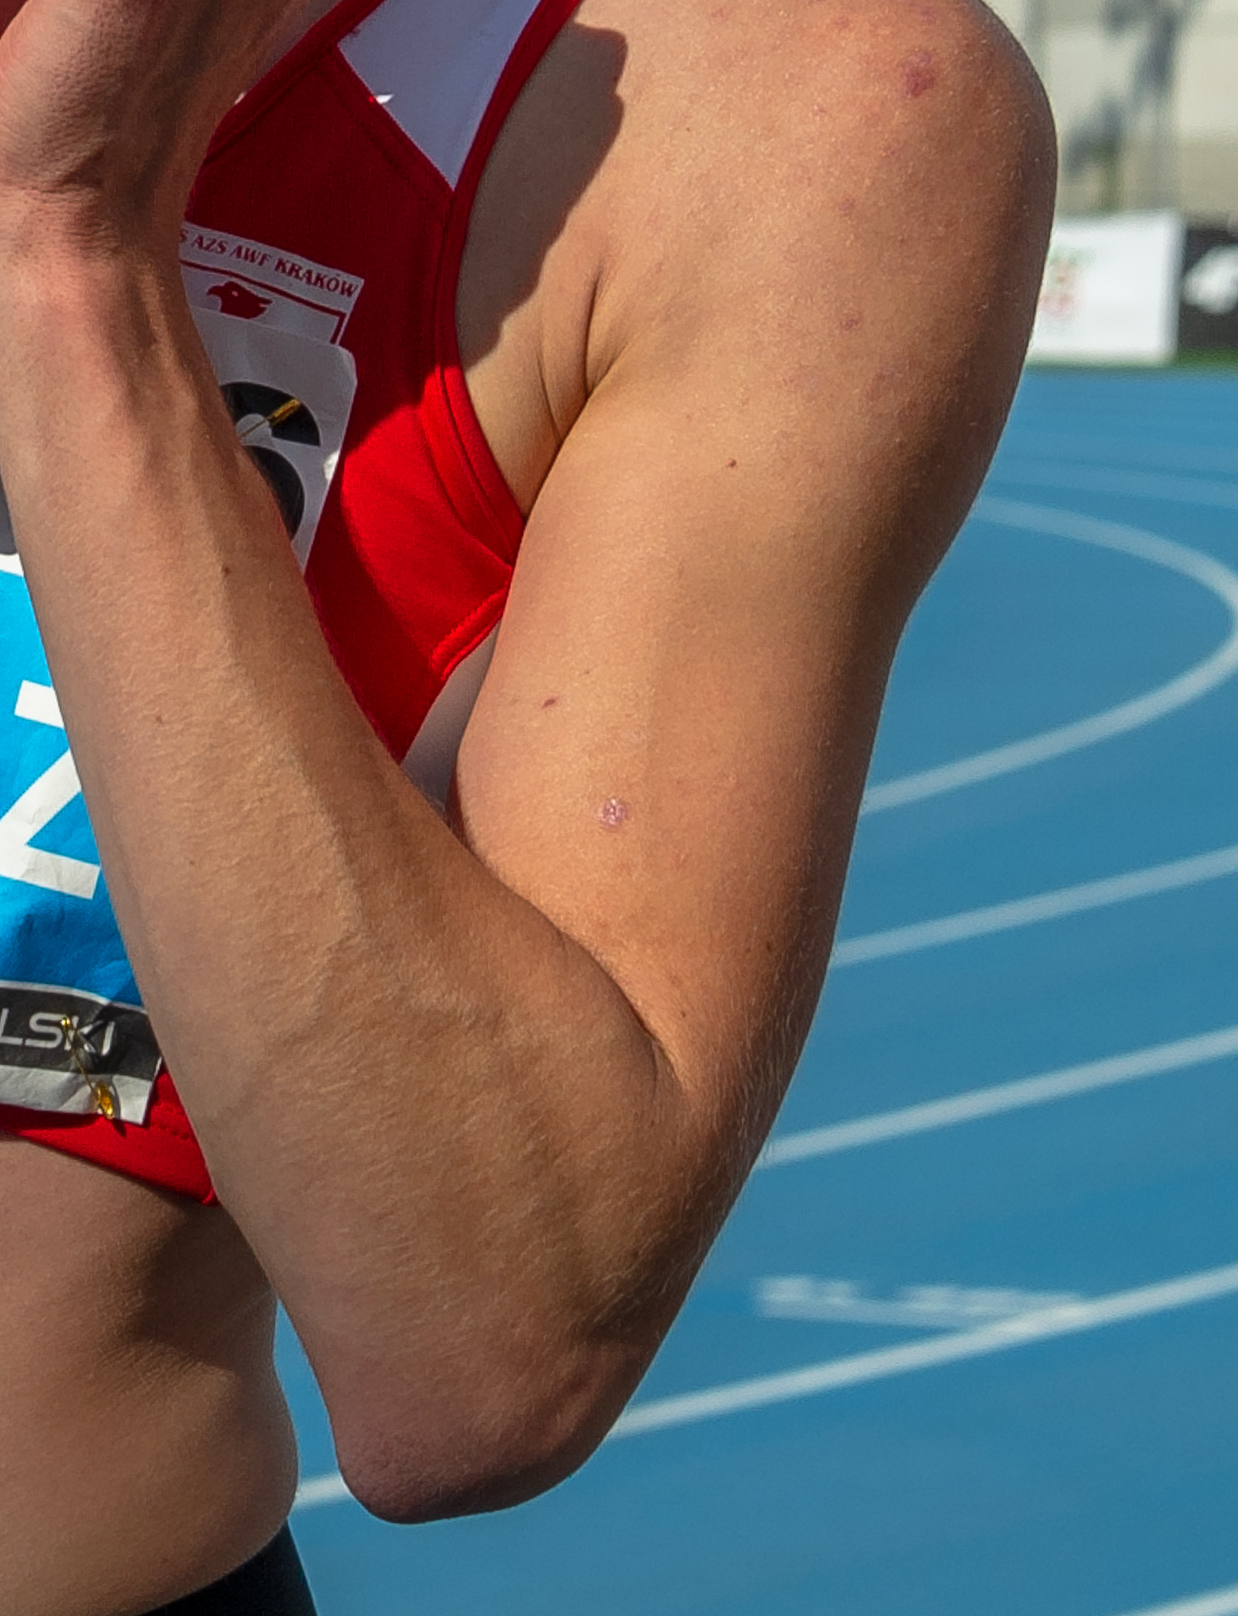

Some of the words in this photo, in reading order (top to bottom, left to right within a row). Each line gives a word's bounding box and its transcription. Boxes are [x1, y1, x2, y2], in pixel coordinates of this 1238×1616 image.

[191, 234, 228, 255] AZS
[229, 244, 272, 267] AWF
[274, 256, 359, 298] KRAKÓW
